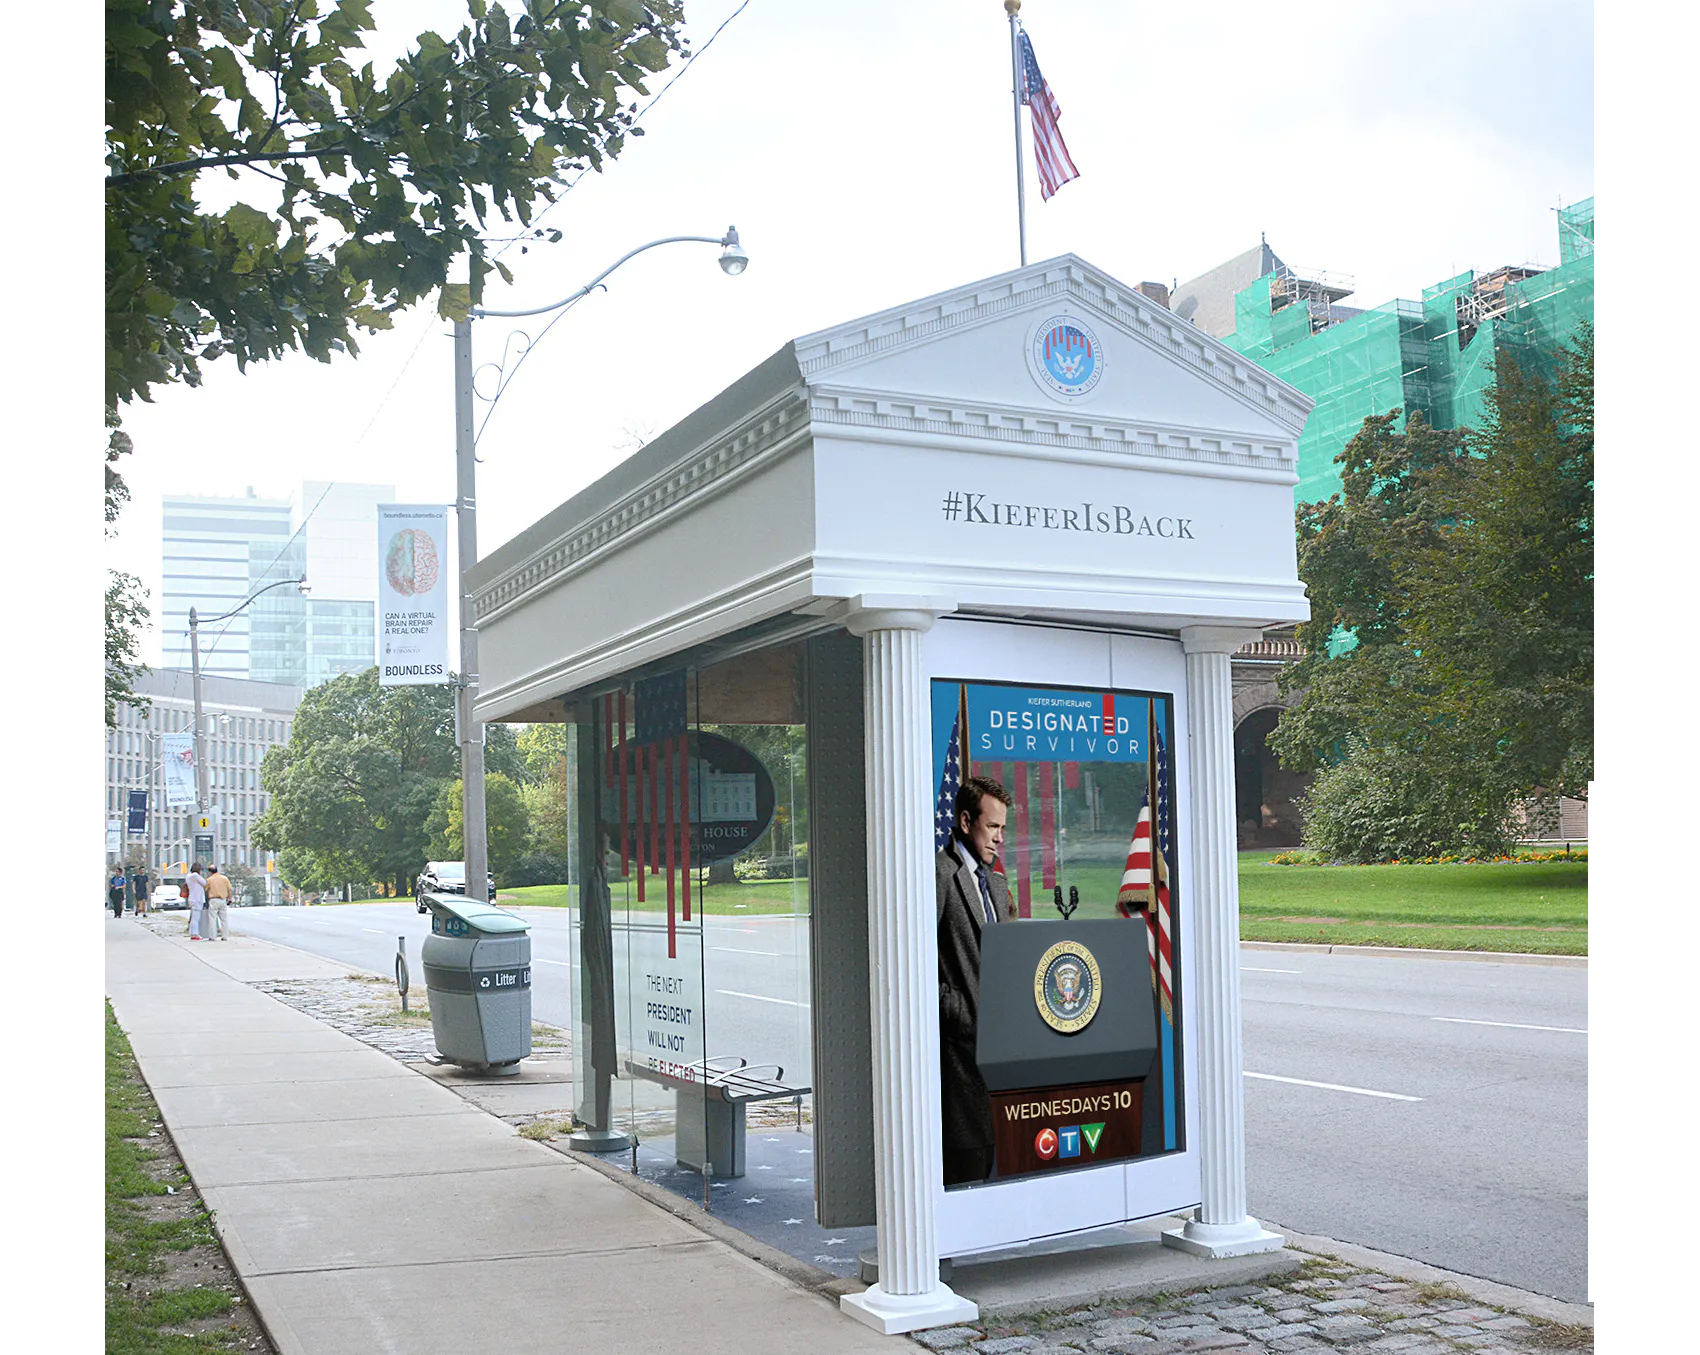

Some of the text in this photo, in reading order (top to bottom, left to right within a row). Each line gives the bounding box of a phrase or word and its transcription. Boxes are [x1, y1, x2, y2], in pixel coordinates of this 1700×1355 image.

[408, 619, 433, 627] REPAIR
[385, 664, 443, 677] BOUNDLESS
[1028, 697, 1092, 708] KIEFER SUTHERLAND
[990, 709, 1129, 734] DESIGNATED
[981, 733, 1139, 755] SURVIVOR
[703, 826, 748, 838] HOUSE
[495, 973, 517, 986] Litter
[646, 974, 683, 995] THE NEXT
[647, 1002, 692, 1026] PRESIDENT
[647, 1030, 685, 1053] WILL NOT
[659, 1060, 696, 1085] ELECTED
[1004, 1090, 1132, 1121] WEDNESDAYS 10
[1038, 1127, 1102, 1155] CTV
